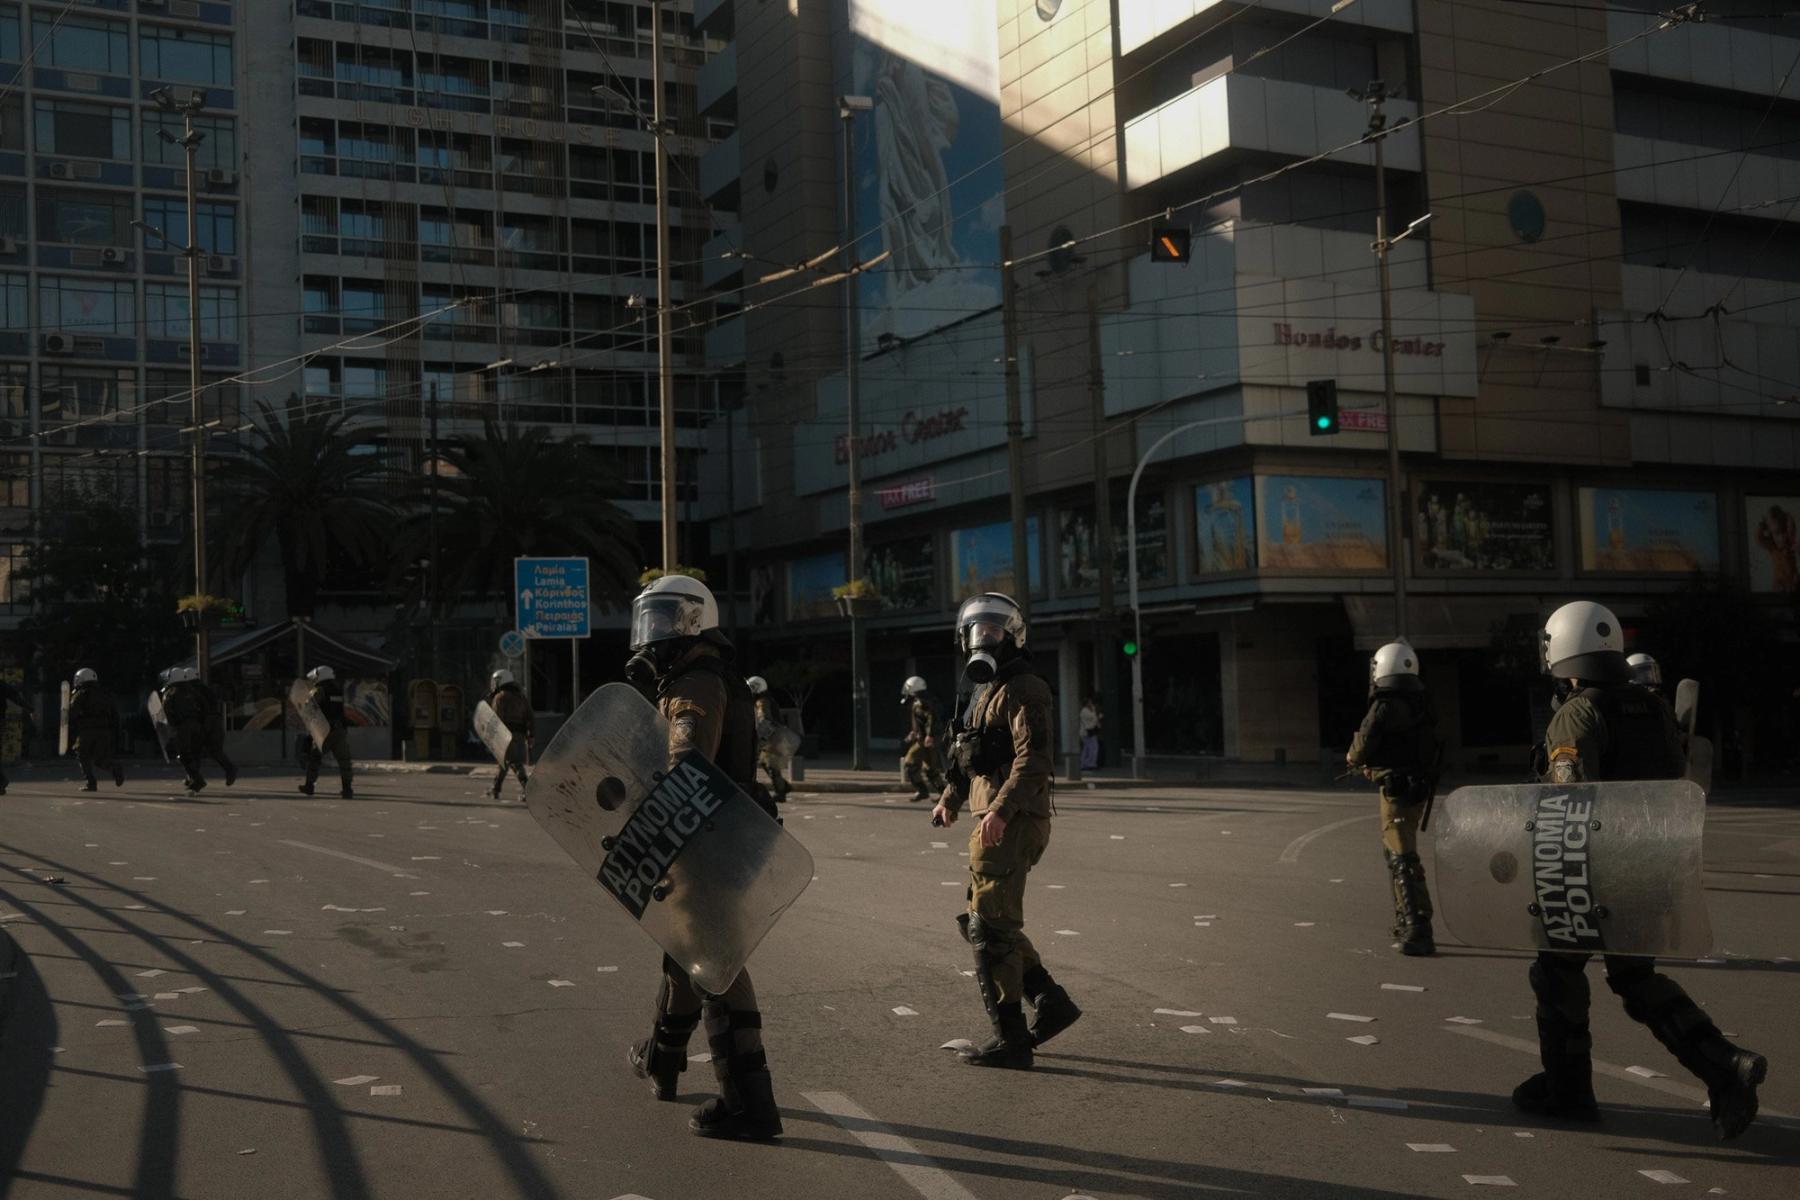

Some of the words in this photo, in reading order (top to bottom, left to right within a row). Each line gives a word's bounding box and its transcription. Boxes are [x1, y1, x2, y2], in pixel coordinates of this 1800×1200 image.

[1274, 322, 1361, 350] Hondos
[1371, 329, 1445, 356] Center
[1338, 411, 1353, 427] AX
[1358, 412, 1386, 428] FRE
[833, 432, 897, 465] Hndos
[534, 564, 565, 576] Λαμία
[535, 576, 565, 586] Lamia
[535, 587, 585, 599] Κόρινθος
[535, 598, 587, 608] Korinthos
[535, 622, 578, 632] Peiraias
[602, 761, 710, 895] ΑΣΤΥΝΟΜΙΑ
[624, 784, 723, 908] POLICE
[1535, 794, 1578, 943] ΑΣΤΥΝΟΜΙΑ
[1563, 800, 1600, 938] POLICE
